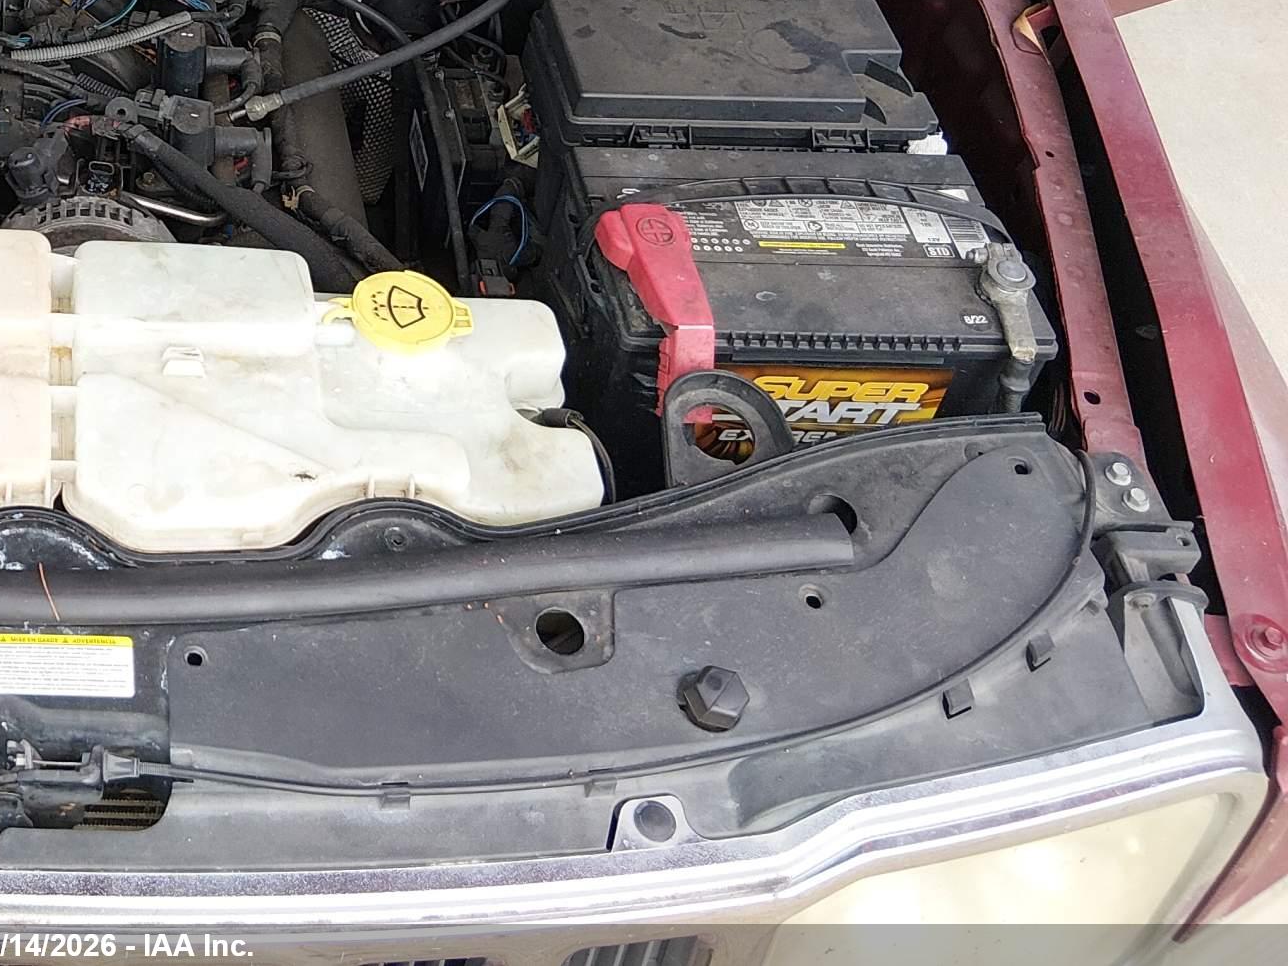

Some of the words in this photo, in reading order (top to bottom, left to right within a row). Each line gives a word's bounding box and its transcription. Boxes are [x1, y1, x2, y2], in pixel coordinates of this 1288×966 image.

[928, 247, 950, 256] STD
[753, 375, 929, 403] SUPER
[776, 399, 920, 425] TART
